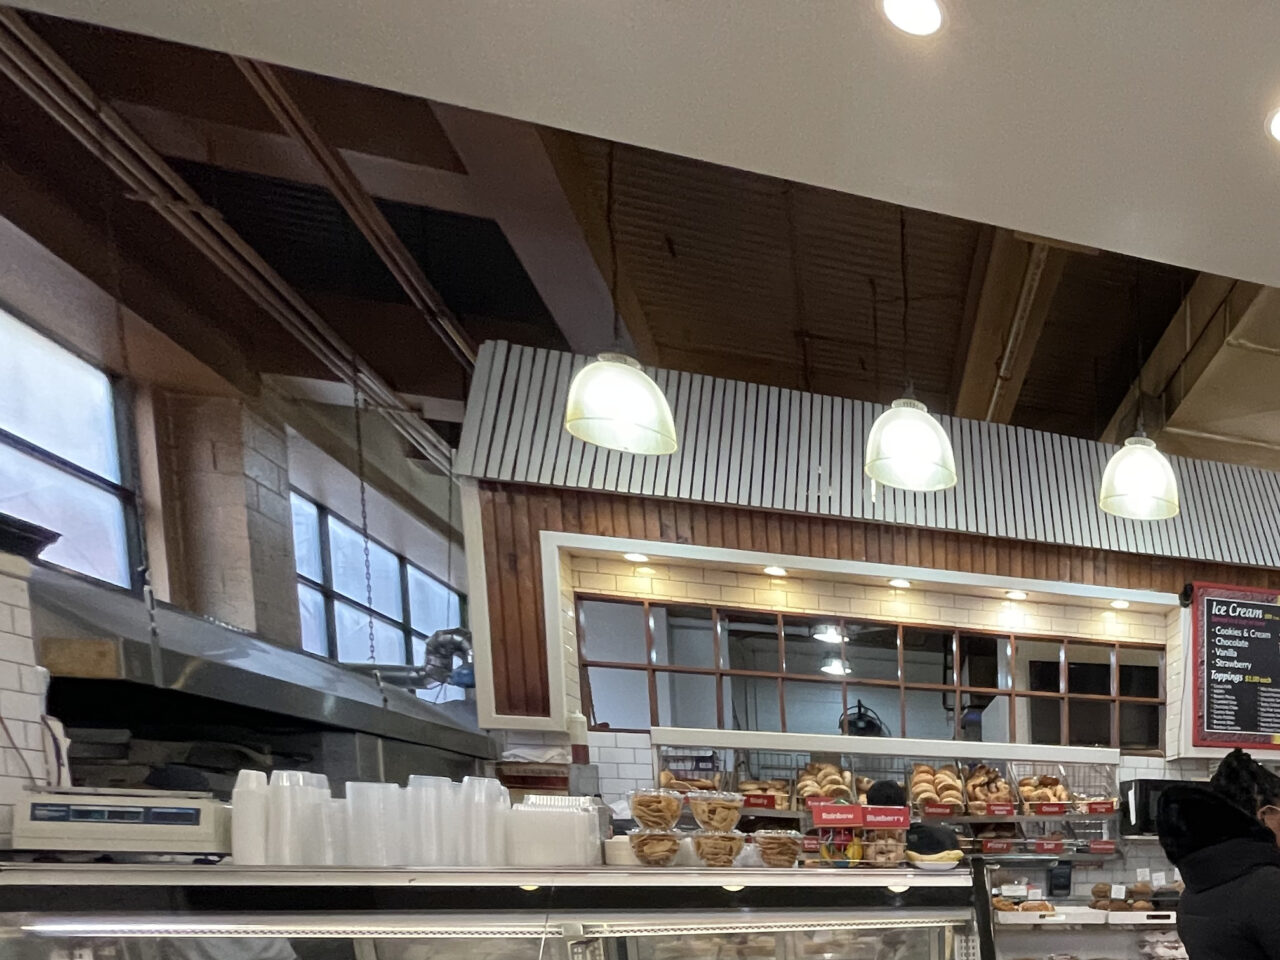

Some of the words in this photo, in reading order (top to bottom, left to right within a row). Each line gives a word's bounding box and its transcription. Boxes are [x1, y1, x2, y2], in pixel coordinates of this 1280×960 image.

[1211, 601, 1227, 616] Ice
[1228, 603, 1263, 619] Cream
[1215, 625, 1242, 637] Cookies
[1242, 628, 1249, 637] &
[1249, 629, 1272, 639] Cream
[1215, 637, 1249, 648] Chocolate
[1215, 647, 1238, 658] Vanilla
[1215, 658, 1252, 670] Strawberry
[1210, 669, 1243, 684] Toppings
[821, 811, 854, 820] Rainbow
[866, 814, 904, 823] Blueberry
